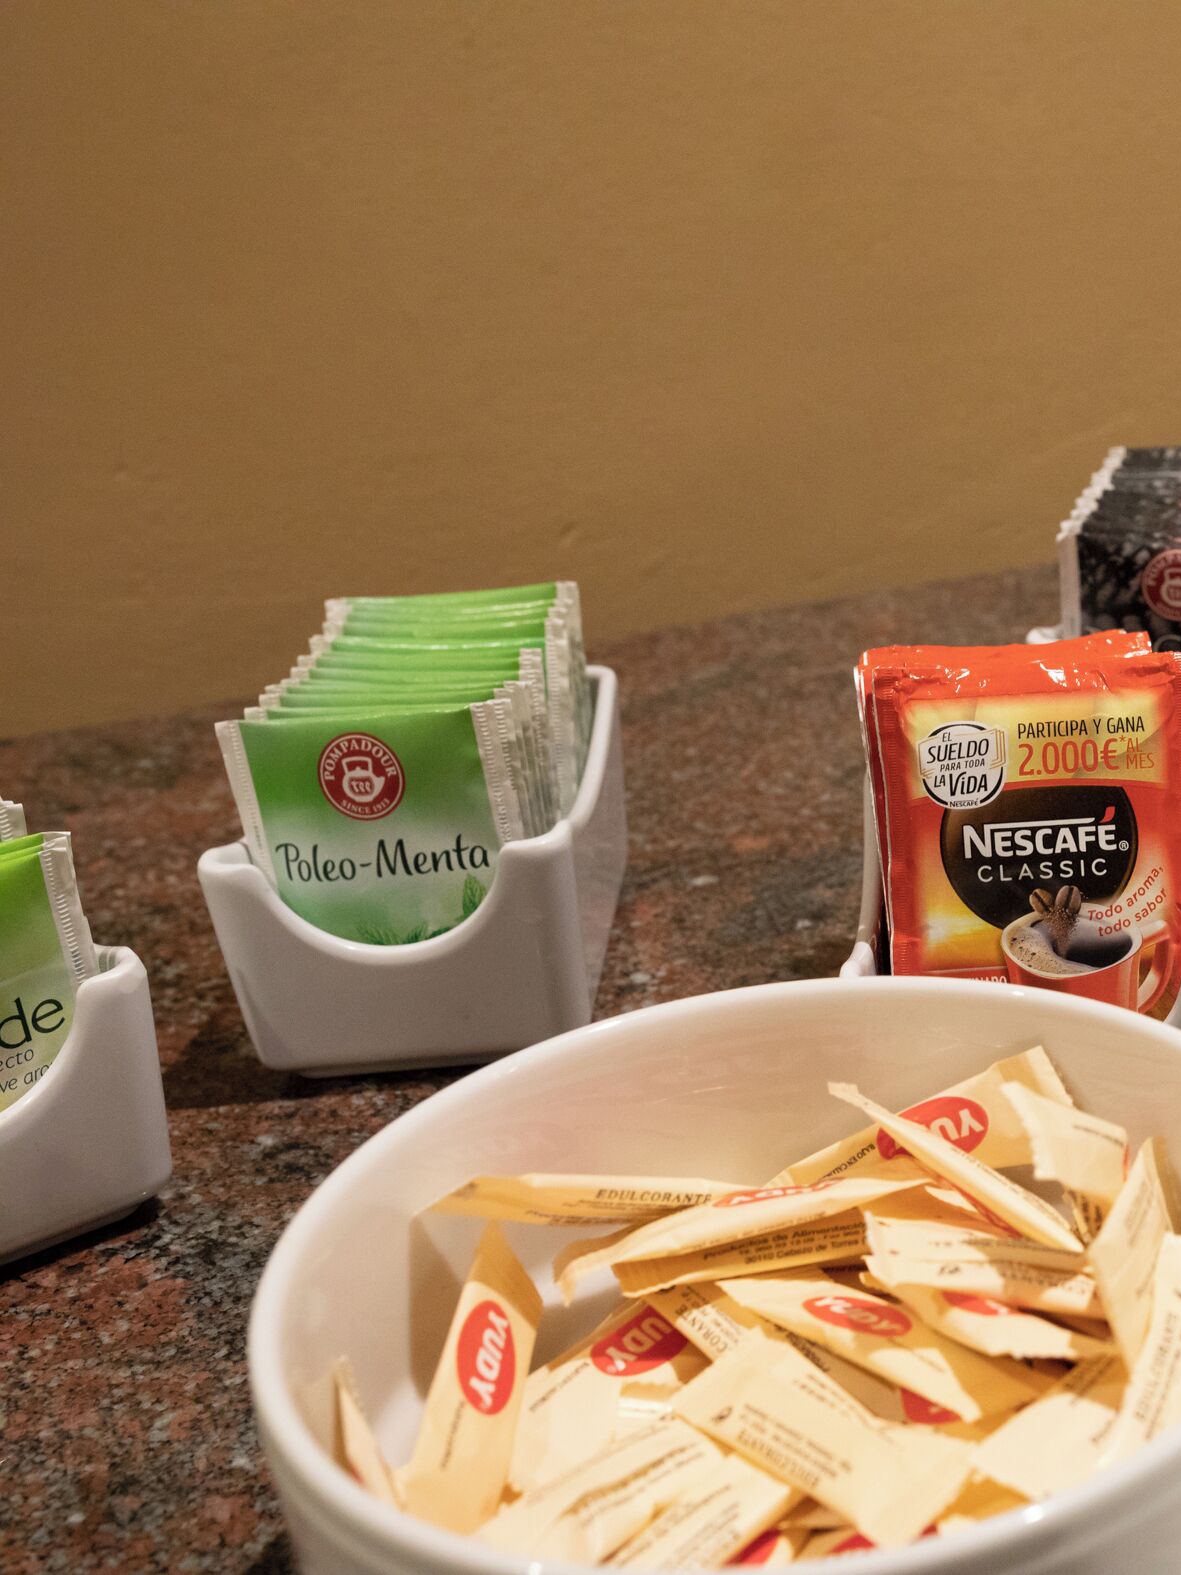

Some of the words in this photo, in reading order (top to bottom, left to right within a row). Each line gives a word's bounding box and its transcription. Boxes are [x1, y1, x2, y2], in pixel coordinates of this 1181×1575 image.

[942, 732, 952, 742] EL
[1017, 720, 1088, 739] PARTICIPA
[1093, 719, 1101, 734] Y
[1107, 716, 1145, 733] GANA
[927, 738, 990, 764] SUELDO
[1126, 737, 1142, 753] AL
[324, 738, 397, 781] POMPADOUR
[940, 762, 961, 772] PARA
[964, 758, 985, 770] TODA
[1126, 753, 1155, 770] MES
[934, 775, 946, 789] LA
[275, 833, 490, 883] Poleo-Menta
[977, 858, 1108, 883] CLASSIC
[1087, 904, 1123, 921] Todo
[1126, 864, 1165, 907] aroma,
[1098, 918, 1131, 937] todo
[1135, 887, 1167, 922] sabor
[604, 1315, 674, 1373] UDY
[469, 1309, 510, 1409] YUDY
